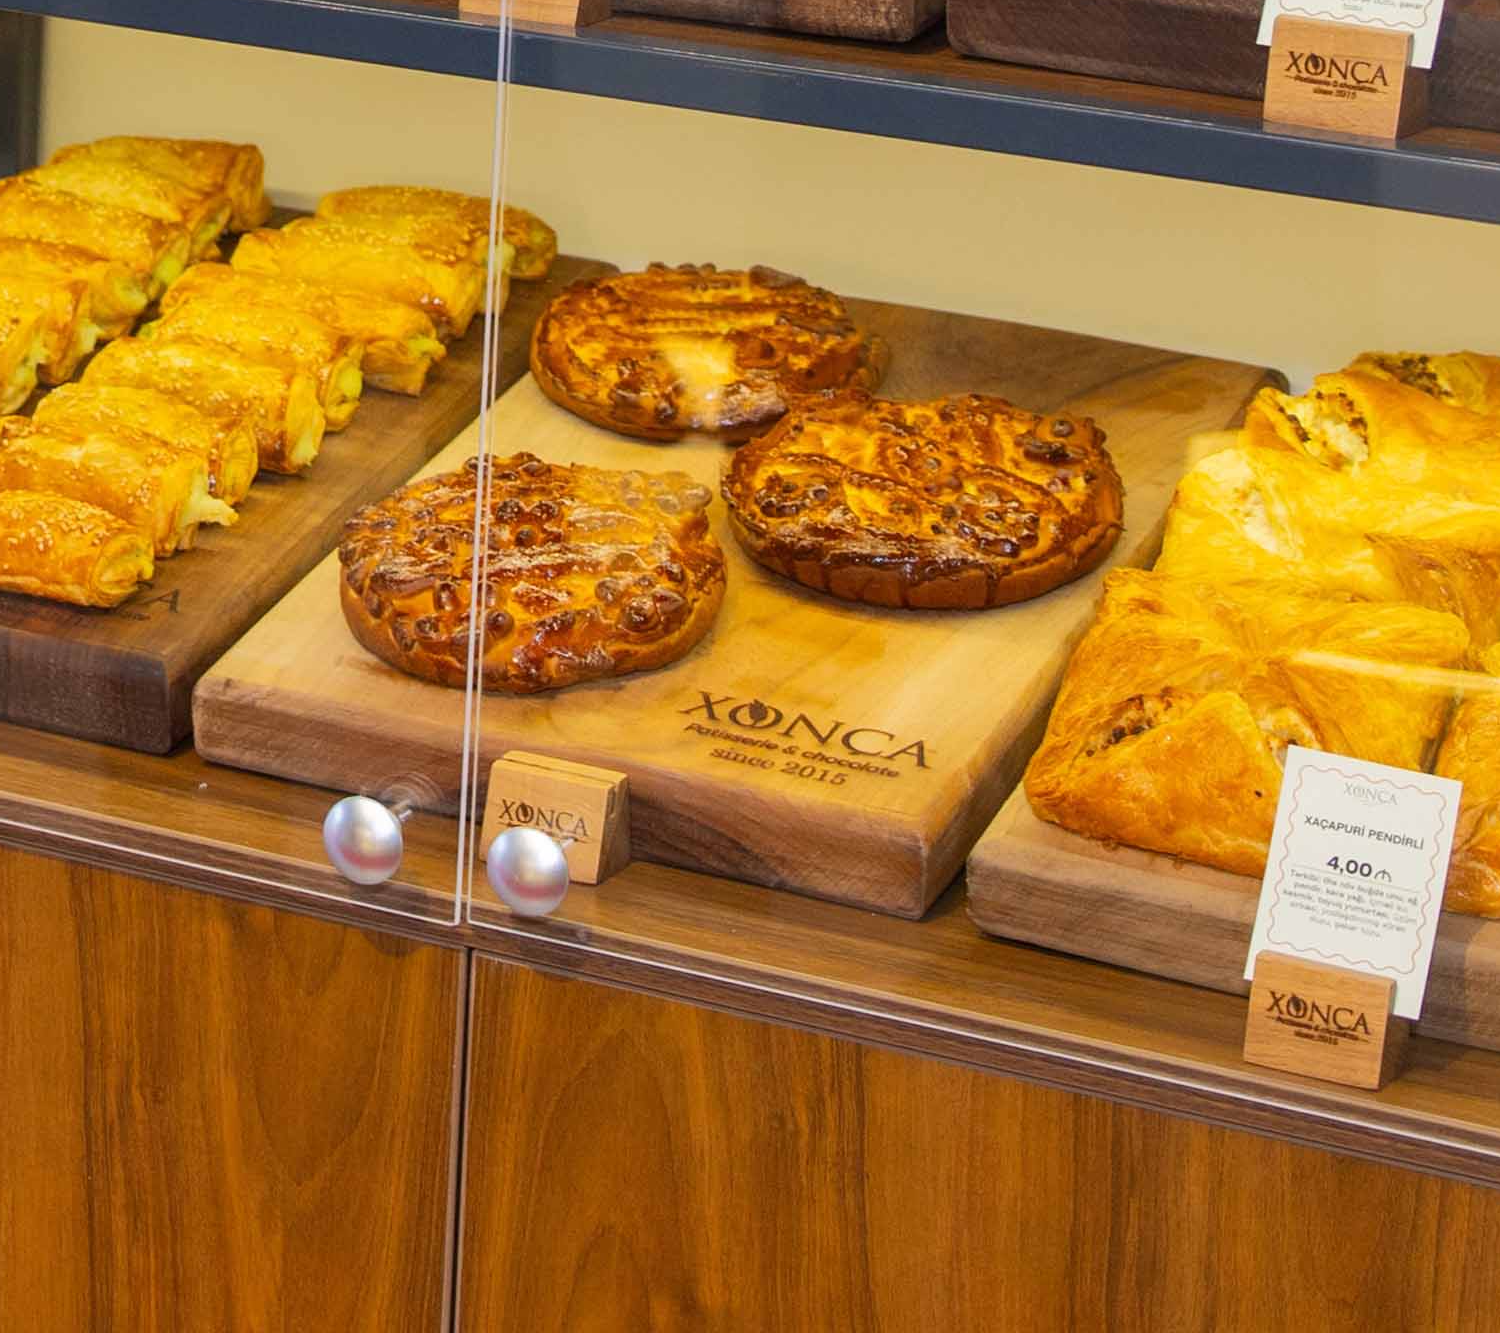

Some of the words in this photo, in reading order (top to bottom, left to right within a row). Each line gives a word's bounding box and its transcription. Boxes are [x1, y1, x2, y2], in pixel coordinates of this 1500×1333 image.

[684, 722, 779, 750] Patisserie
[802, 749, 900, 779] chocolate
[710, 746, 775, 770] since
[781, 760, 849, 785] 2015
[1304, 815, 1366, 838] XAÇAPURİ
[1368, 827, 1424, 851] PENDİRLİ
[1326, 856, 1373, 878] 4,00
